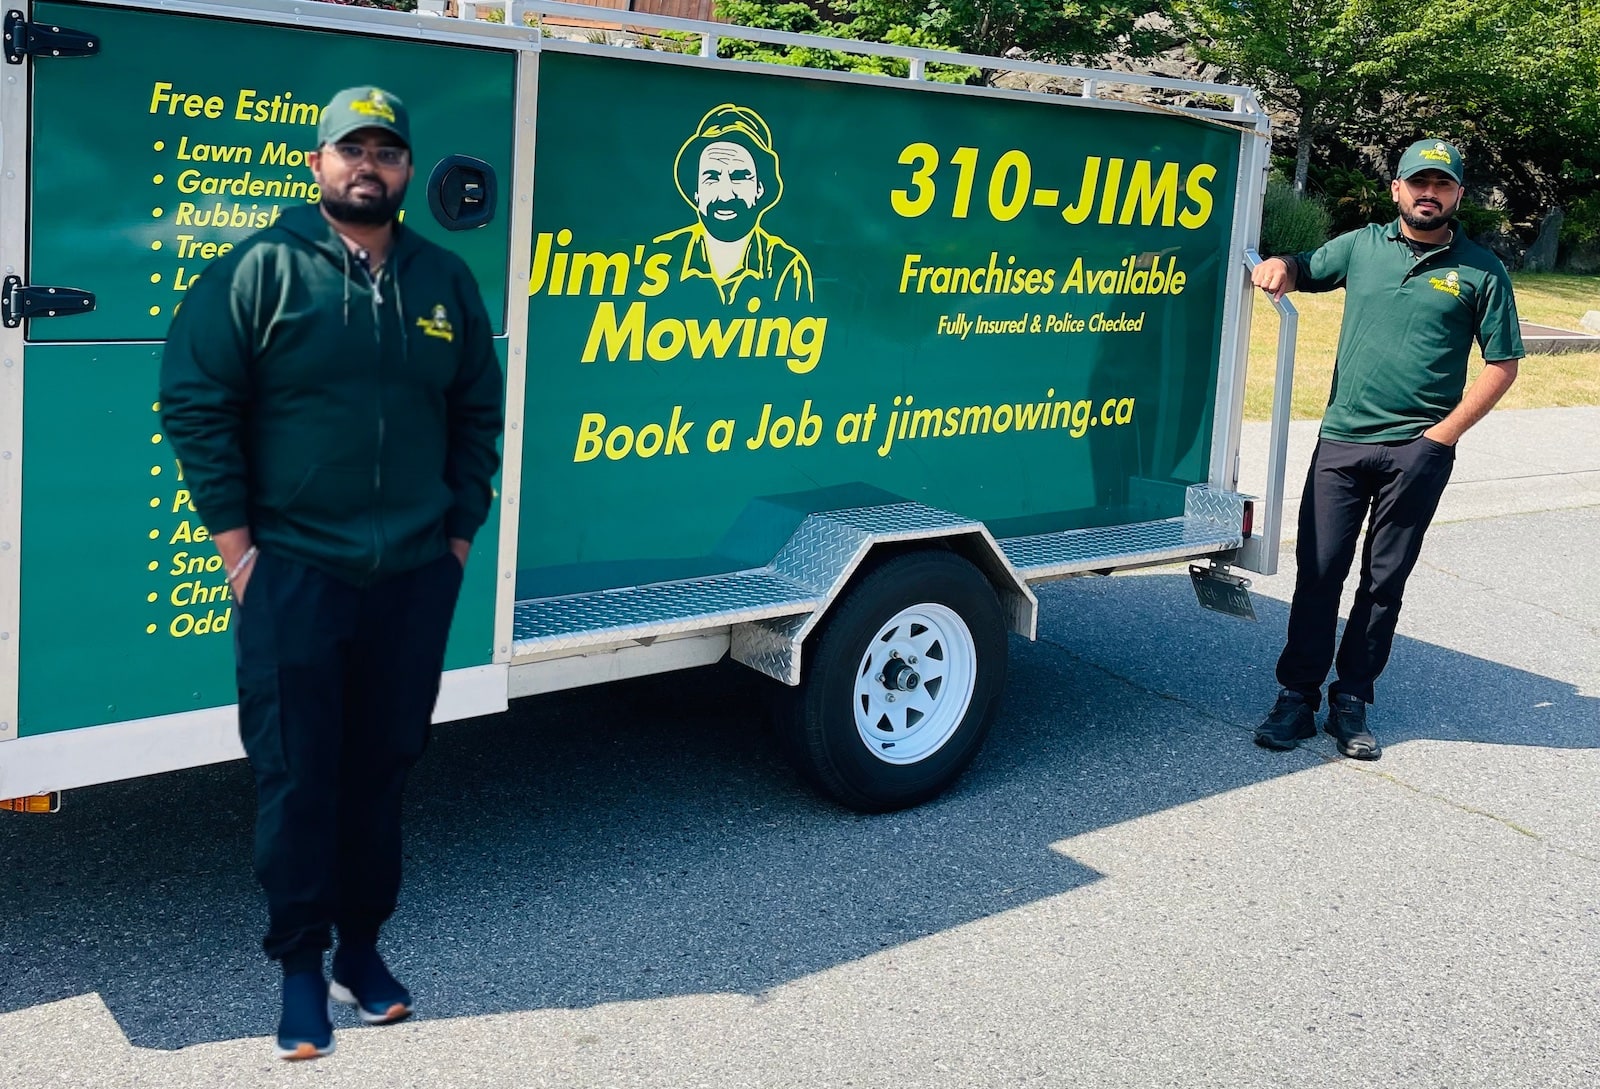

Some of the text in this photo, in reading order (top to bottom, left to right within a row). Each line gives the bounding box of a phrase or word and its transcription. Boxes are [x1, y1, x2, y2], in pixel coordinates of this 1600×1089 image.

[149, 81, 224, 119] Free
[177, 136, 252, 164] Lawn
[177, 169, 322, 204] Gardening
[890, 142, 1217, 230] 310-JIMS
[528, 228, 673, 297] Jim's
[899, 251, 1187, 295] Franchises Available
[580, 296, 828, 375] Mowing
[937, 312, 1145, 340] Fully Insured & Police Checked
[573, 388, 1135, 463] Book a Job at jimsmowing.ca
[169, 607, 232, 638] Odd
